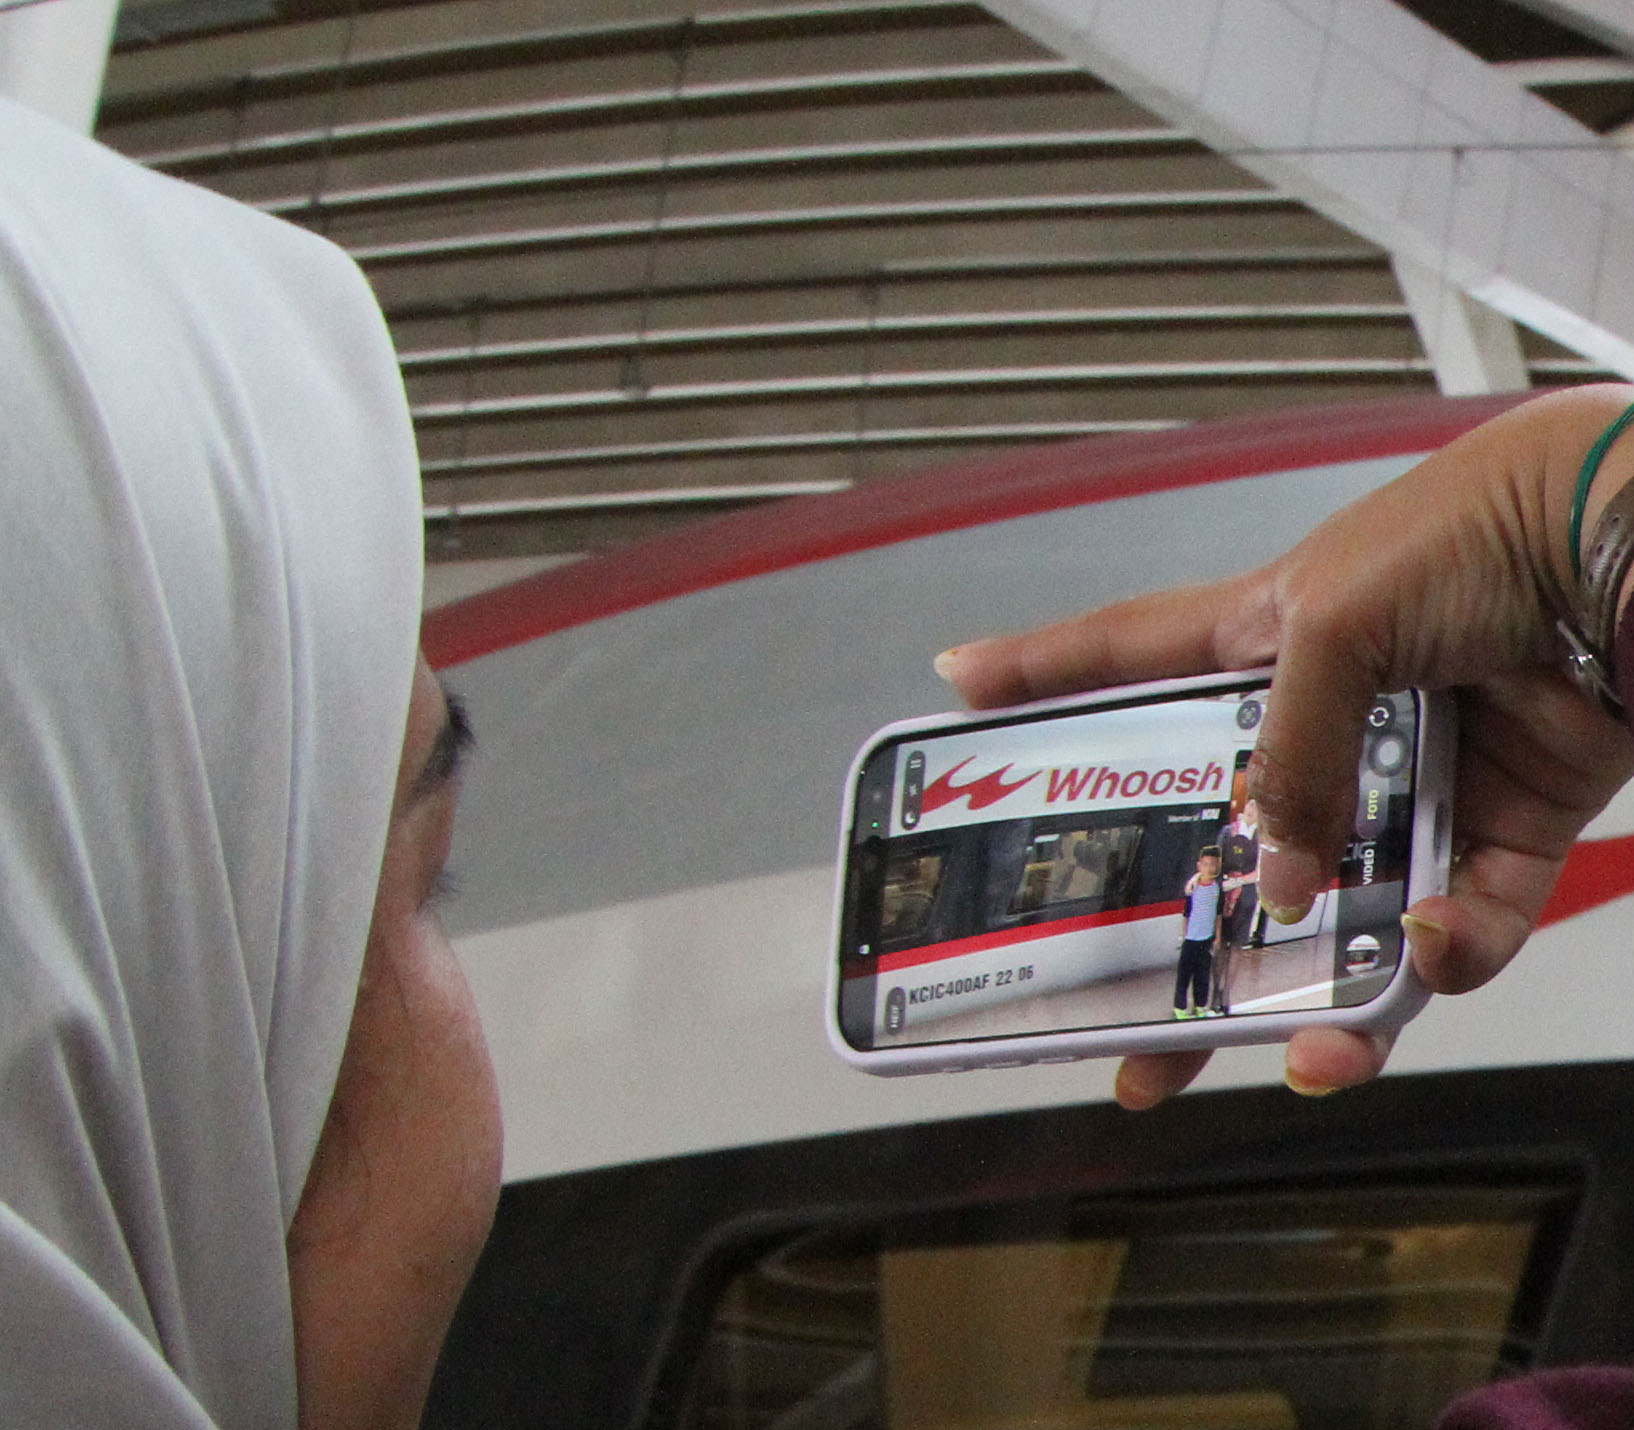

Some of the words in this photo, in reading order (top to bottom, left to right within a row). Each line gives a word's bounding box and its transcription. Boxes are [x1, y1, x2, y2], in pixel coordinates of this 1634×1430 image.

[1046, 762, 1224, 803] Whoosh
[1367, 789, 1379, 820] FOTO
[1363, 848, 1375, 885] VIDEO
[909, 973, 989, 1004] KCIC400AF
[995, 969, 1013, 986] 22
